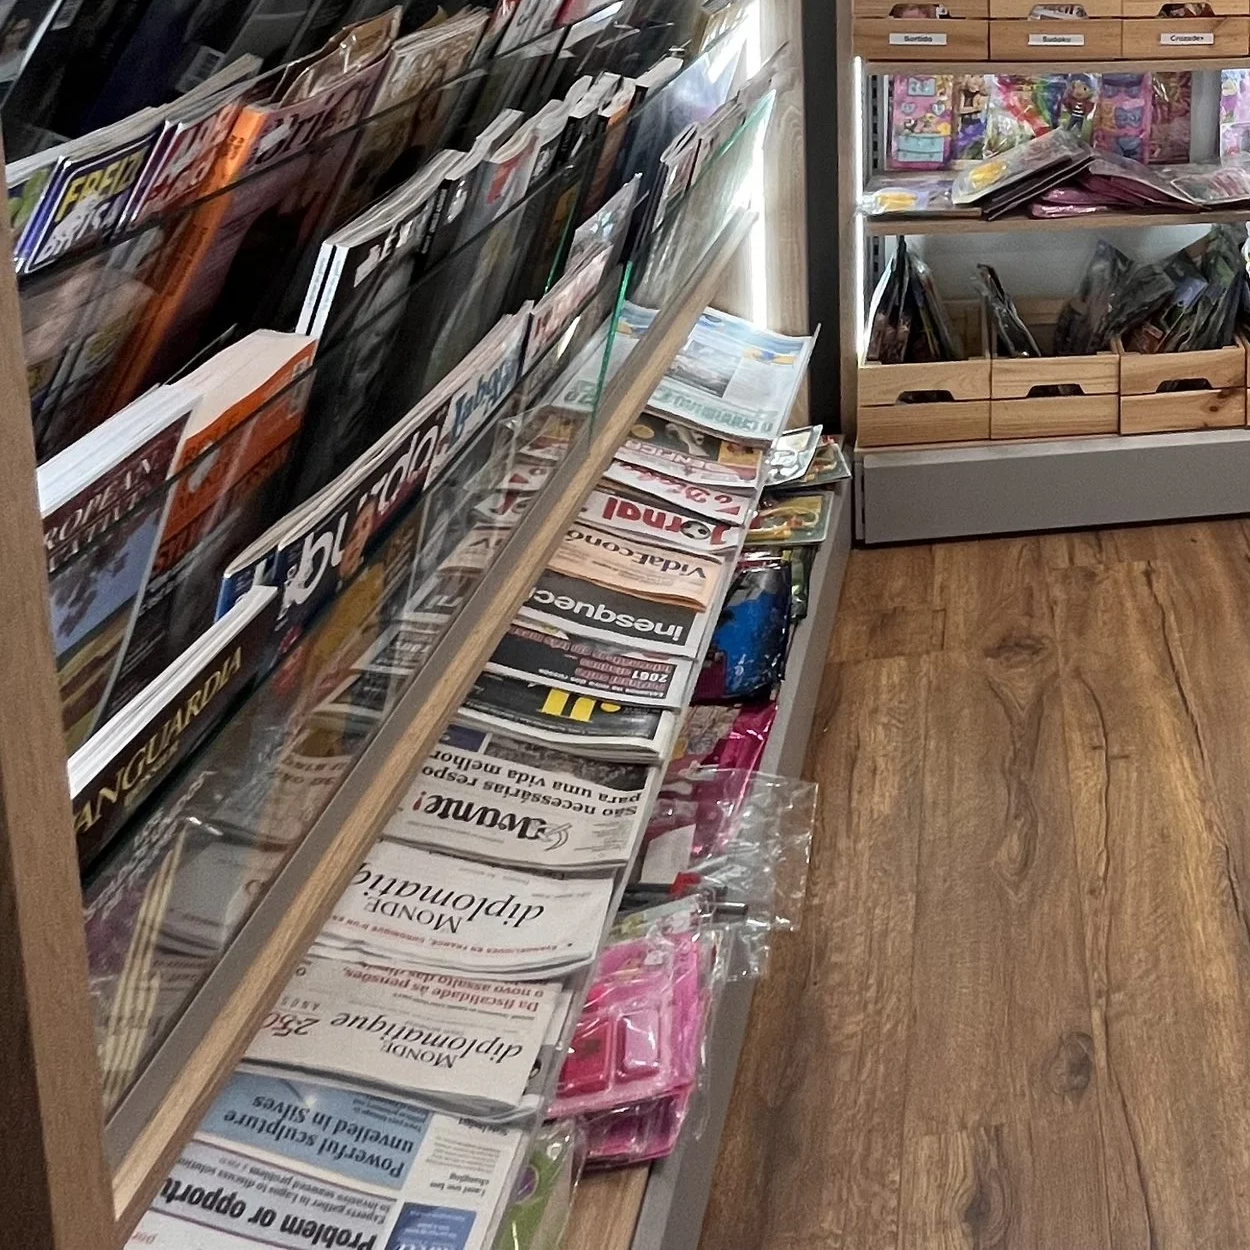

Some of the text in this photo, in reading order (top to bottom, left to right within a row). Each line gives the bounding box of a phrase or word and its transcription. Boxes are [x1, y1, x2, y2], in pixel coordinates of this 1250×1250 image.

[563, 528, 707, 580] VidaEconó
[530, 586, 684, 643] inesquec
[421, 765, 638, 819] São necessárias respo
[428, 750, 641, 806] para uma vida melhor
[342, 967, 540, 1014] Da fiscalidade às pensões,
[437, 975, 532, 997] novo assalto
[331, 1010, 524, 1064] diplomatique
[222, 1110, 405, 1179] Powerful sculpture
[250, 1095, 415, 1156] unveiled in Silves
[247, 1206, 378, 1250] Problem or
